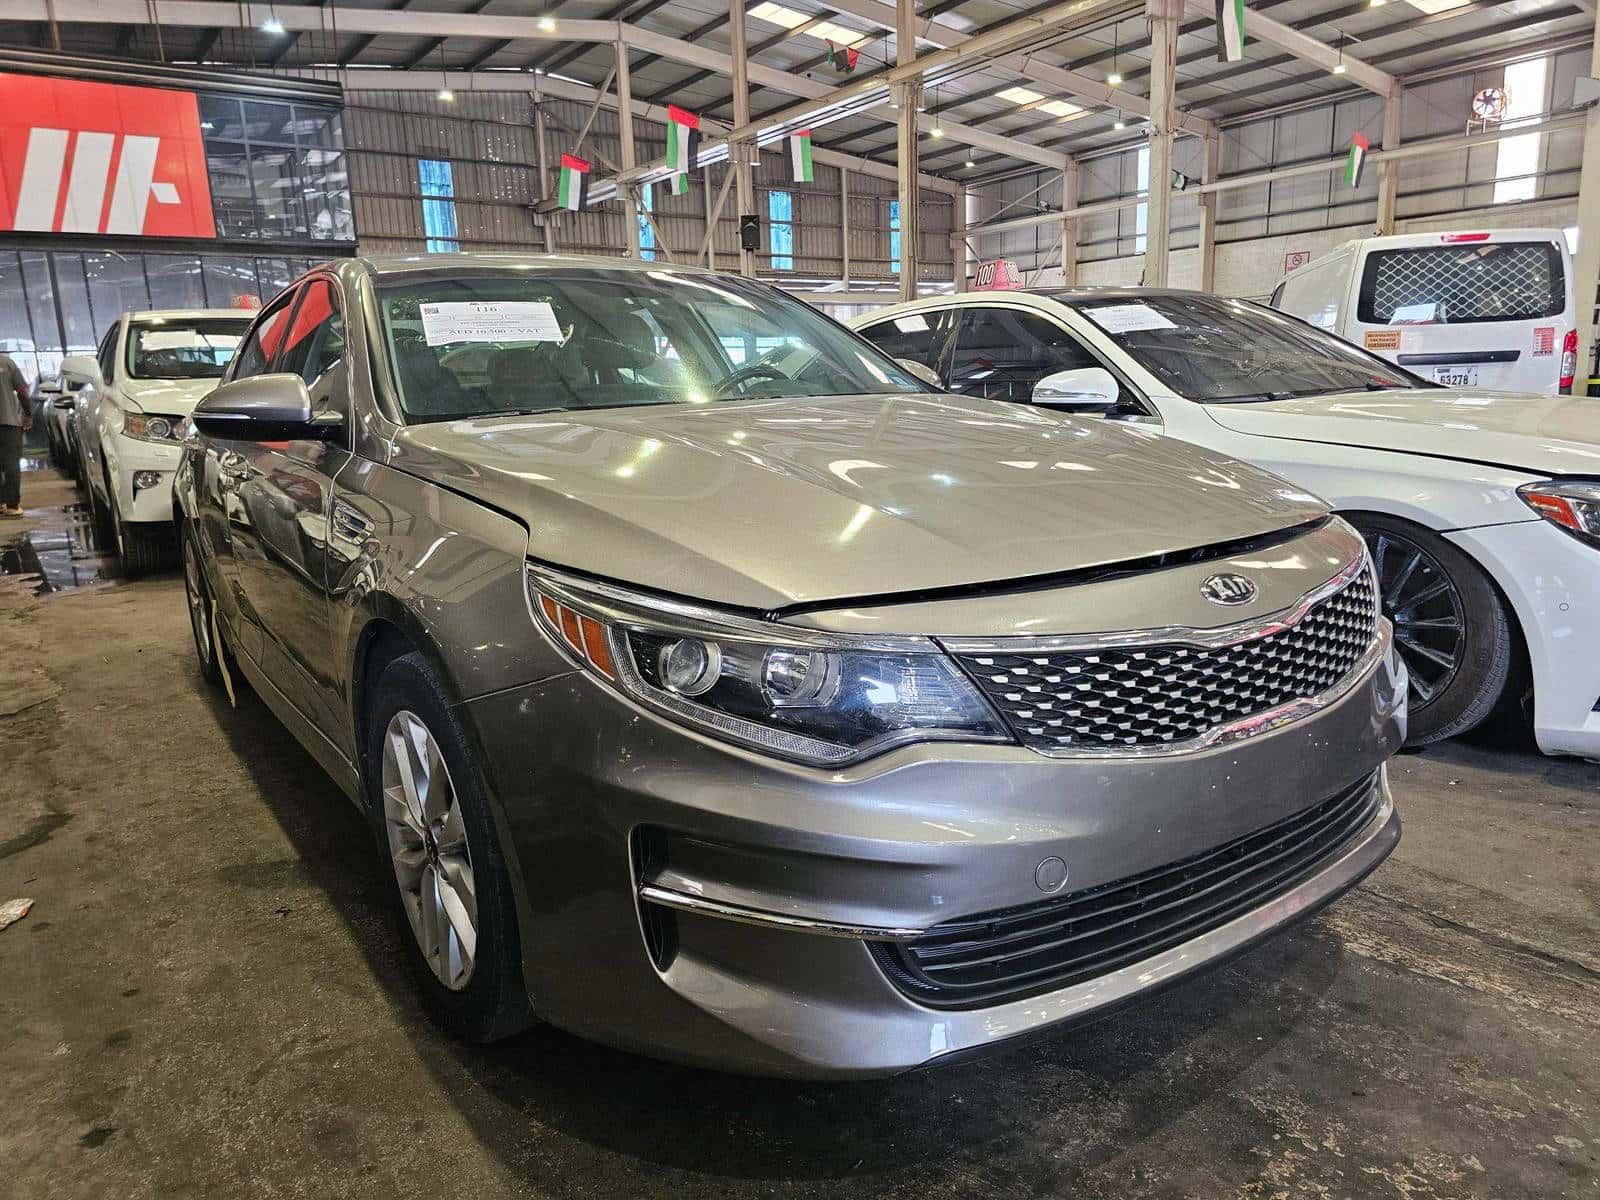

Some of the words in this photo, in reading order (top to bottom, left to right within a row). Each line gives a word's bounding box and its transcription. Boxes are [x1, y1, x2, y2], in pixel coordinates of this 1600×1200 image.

[975, 263, 995, 287] 100
[1440, 374, 1469, 385] 63278
[1207, 577, 1253, 600] KIA
